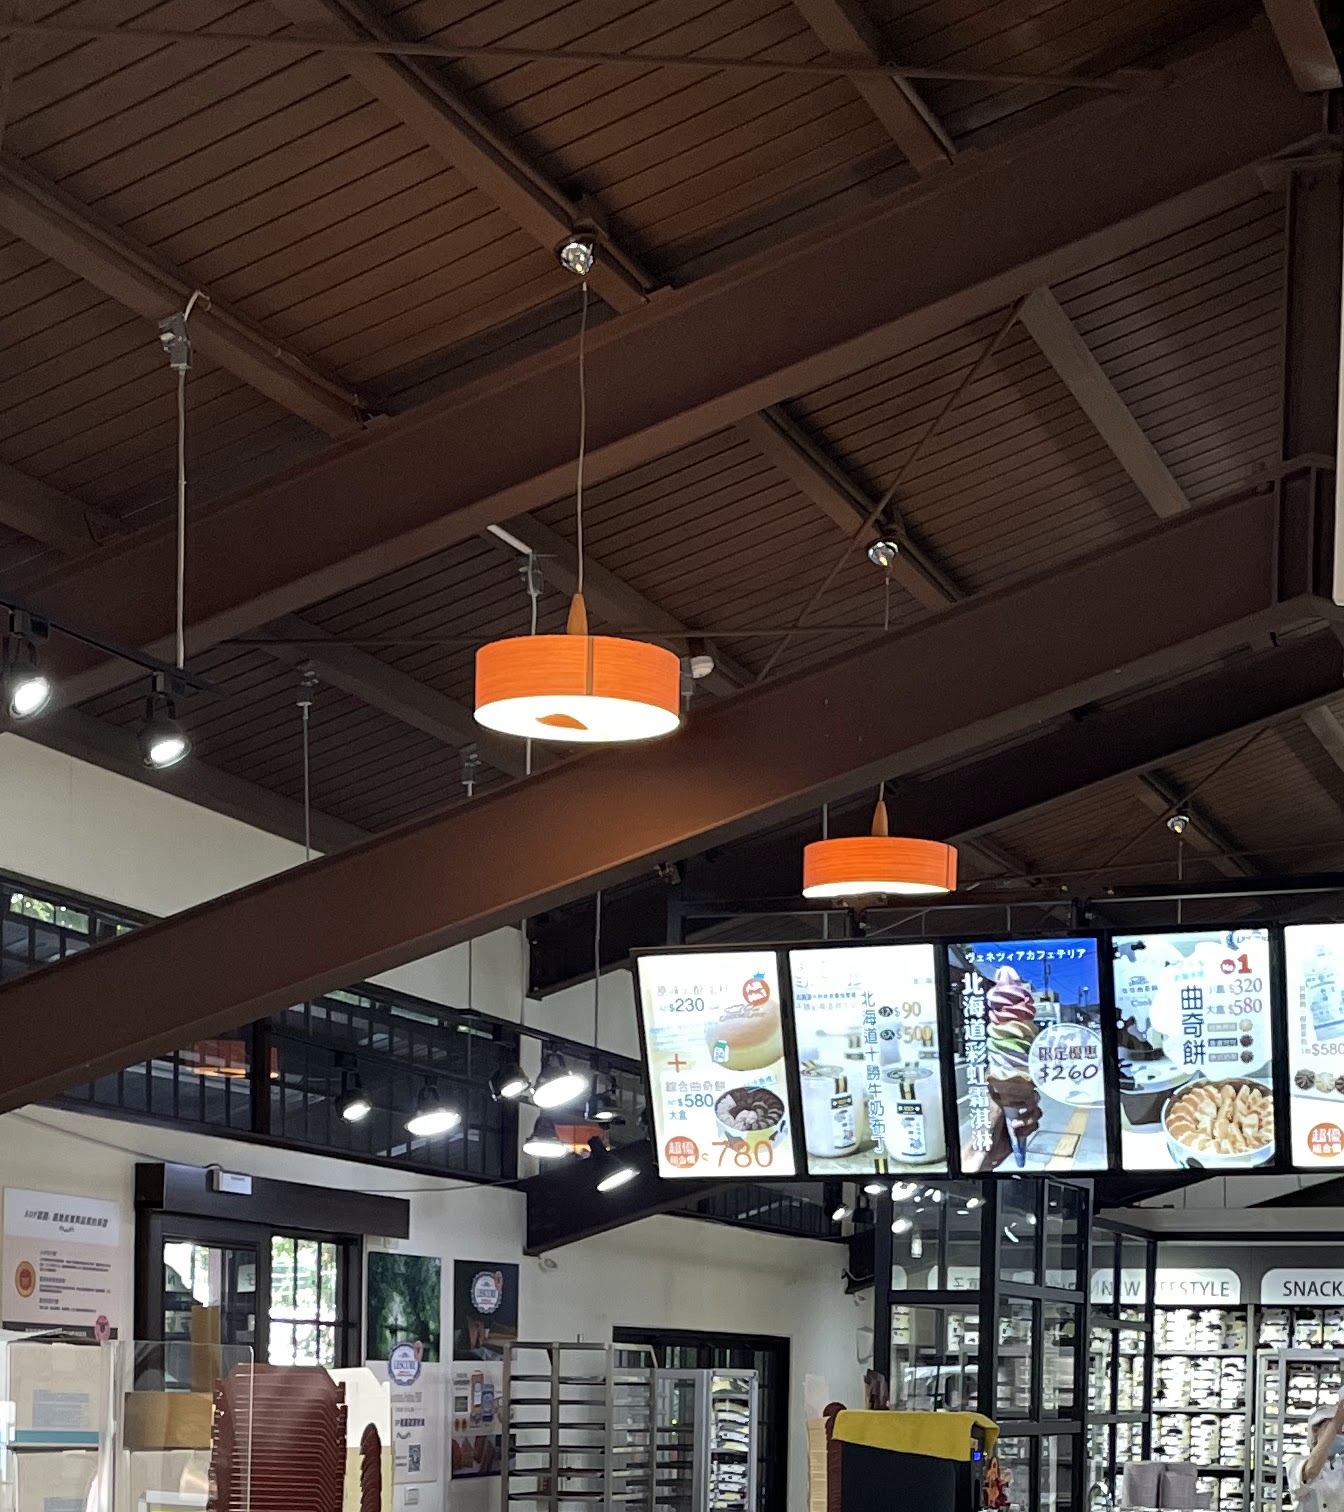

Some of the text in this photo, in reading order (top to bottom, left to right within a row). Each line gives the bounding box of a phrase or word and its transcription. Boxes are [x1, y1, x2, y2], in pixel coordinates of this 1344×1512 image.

[1228, 997, 1262, 1016] $580
[1229, 978, 1262, 995] $320
[1181, 985, 1206, 1065] 曲奇餅
[861, 991, 885, 1154] 北海道十勝牛奶布丁
[961, 971, 993, 1152] 北海道彩虹霜淇淋
[1039, 1064, 1098, 1082] $260
